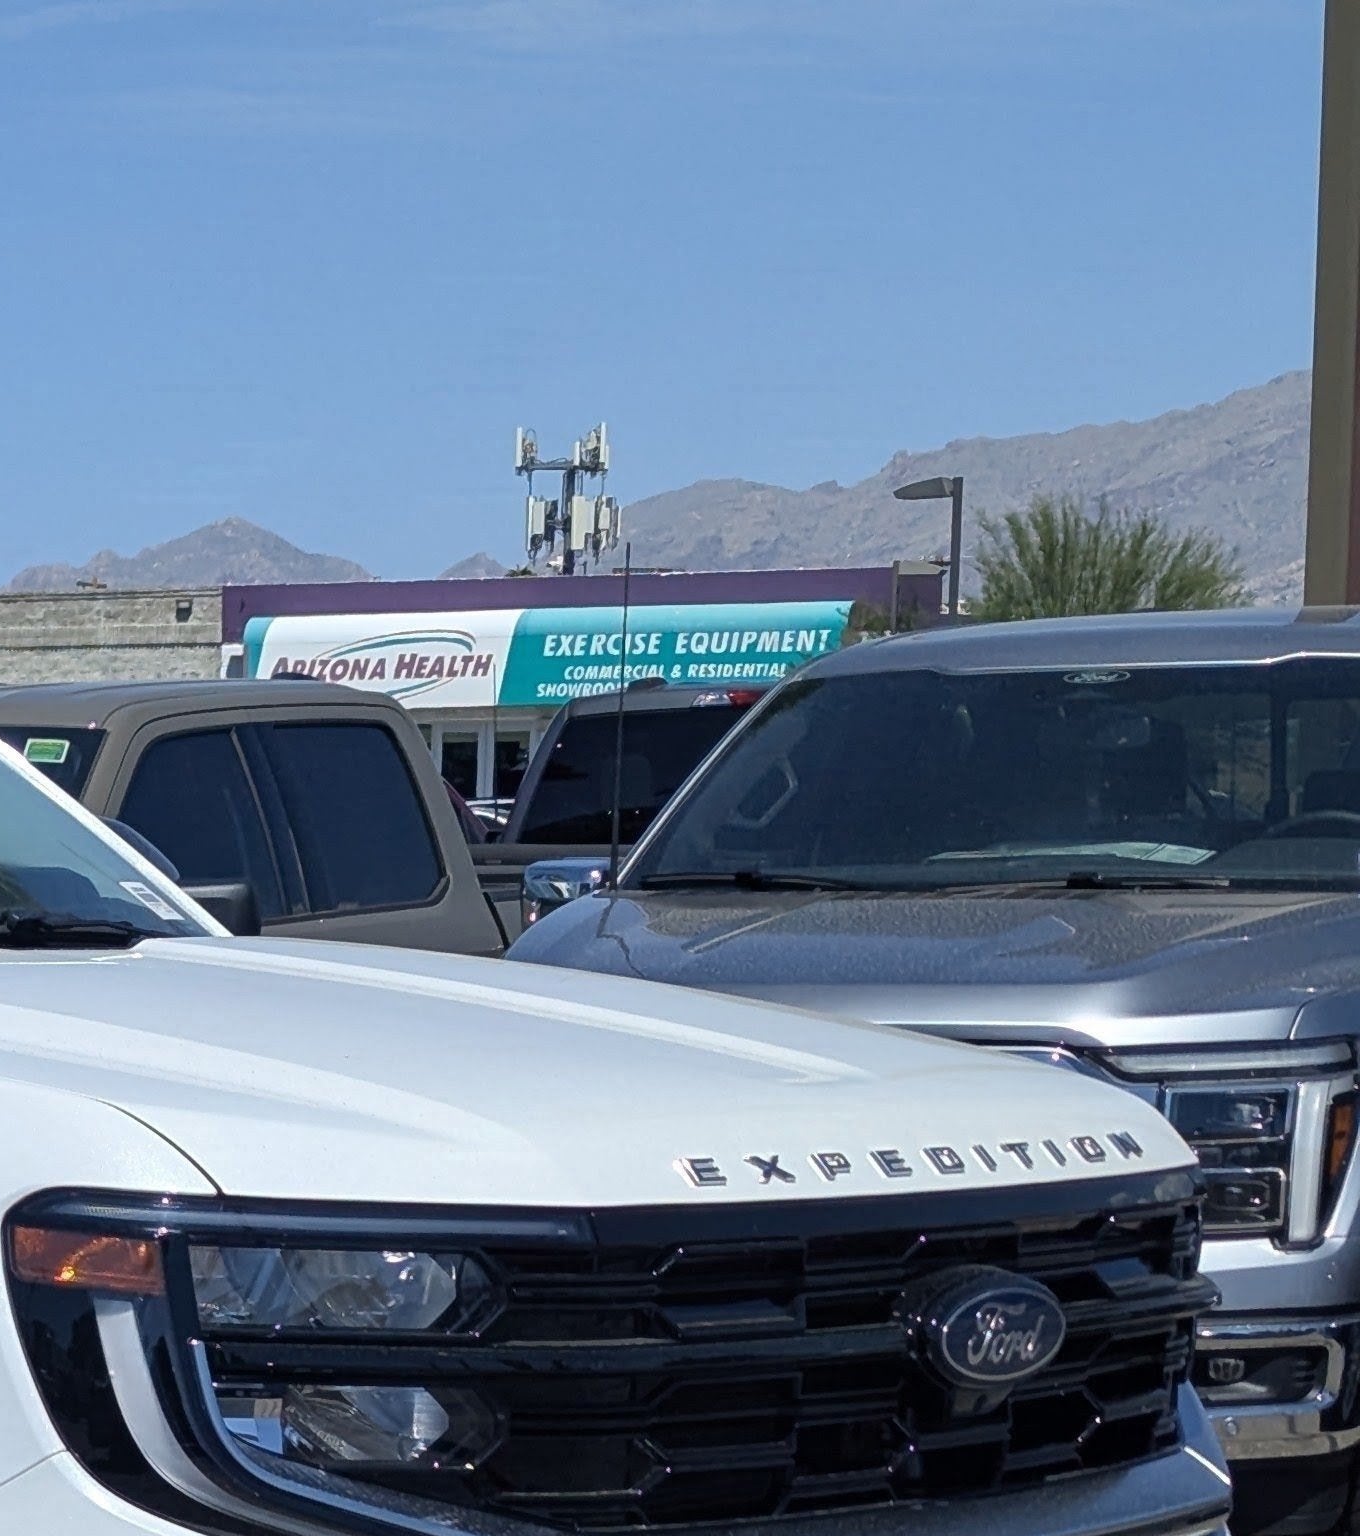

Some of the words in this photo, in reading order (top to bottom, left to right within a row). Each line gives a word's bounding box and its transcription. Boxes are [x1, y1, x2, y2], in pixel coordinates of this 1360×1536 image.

[542, 632, 663, 657] EXERCISE
[674, 629, 832, 655] EQUIPMENT
[393, 653, 494, 680] HEALTH
[563, 663, 665, 680] COMMERCIAL
[670, 664, 682, 678] &
[687, 662, 787, 678] RESIDENTIAL
[677, 1130, 1144, 1188] EXPEDITION
[966, 1303, 1043, 1365] Ford
